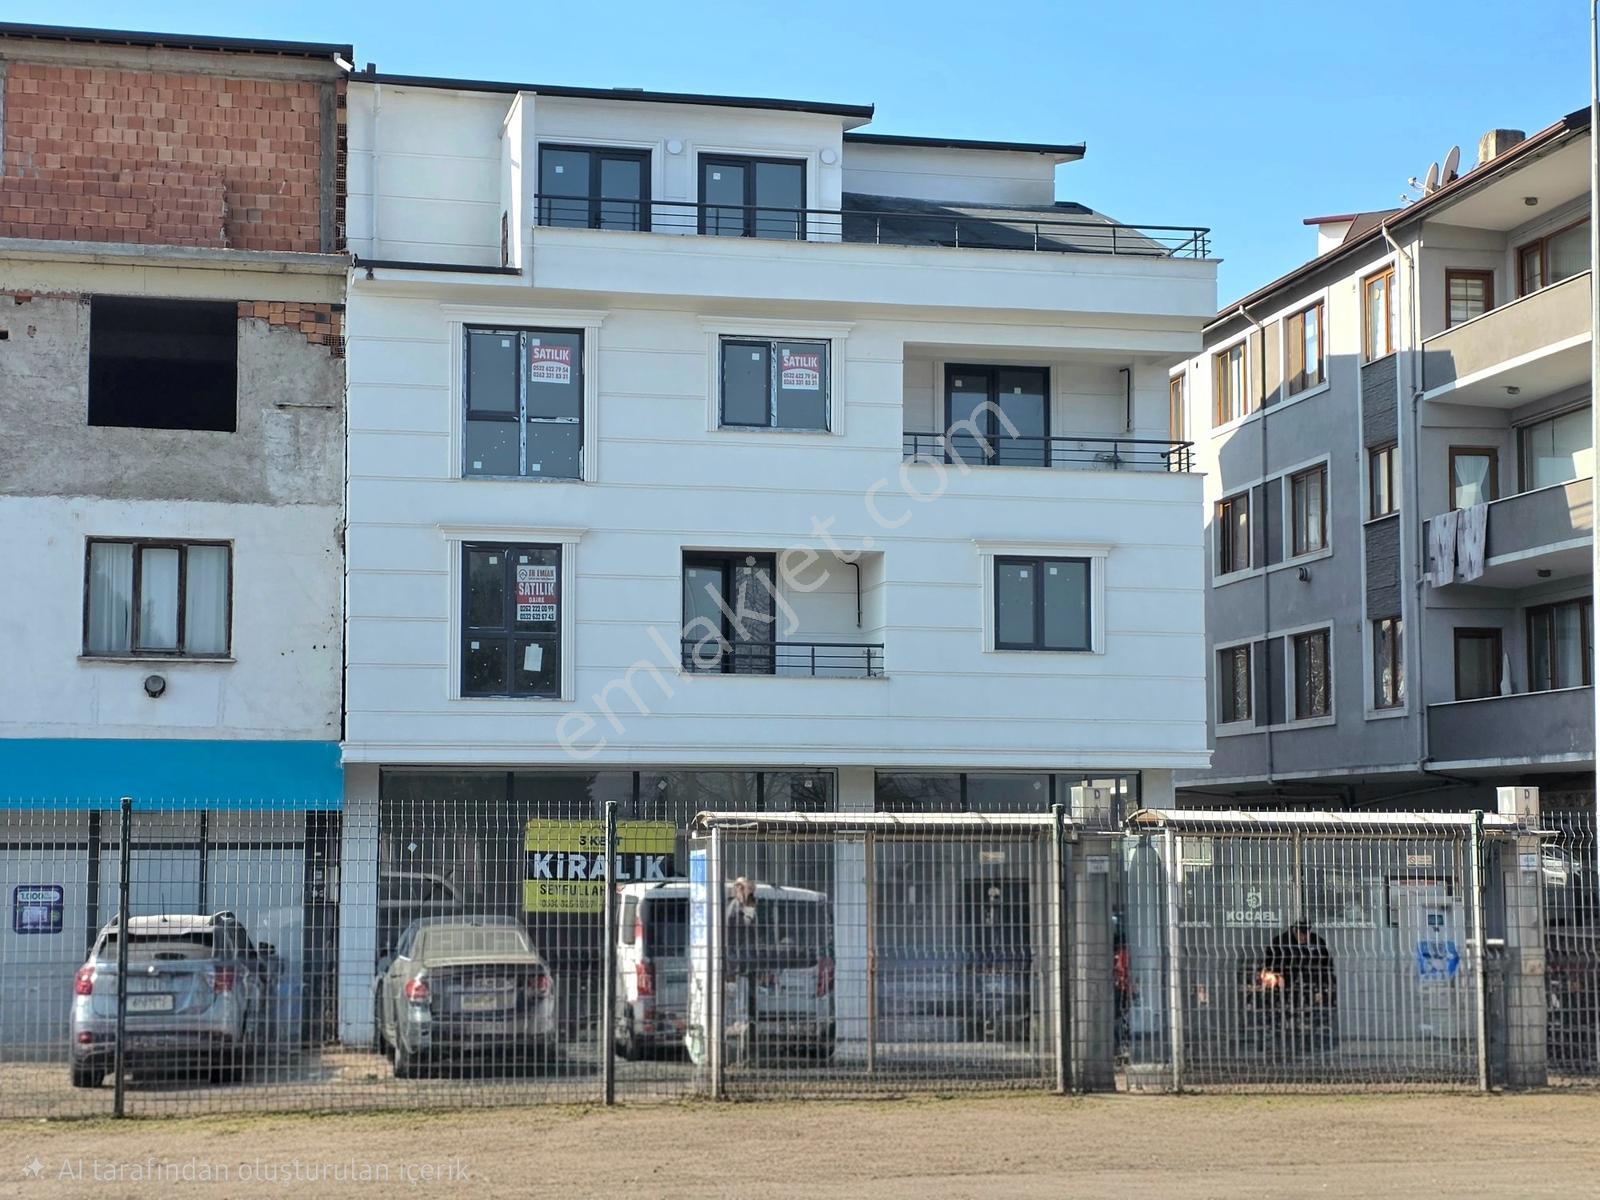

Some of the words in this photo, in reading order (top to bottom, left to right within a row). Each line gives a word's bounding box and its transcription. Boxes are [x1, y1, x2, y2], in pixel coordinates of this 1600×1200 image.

[533, 347, 569, 361] SATILIK
[783, 355, 817, 368] SATILIK
[518, 582, 554, 596] SATILIK
[590, 836, 625, 847] KET
[1226, 909, 1282, 921] KOCAEL
